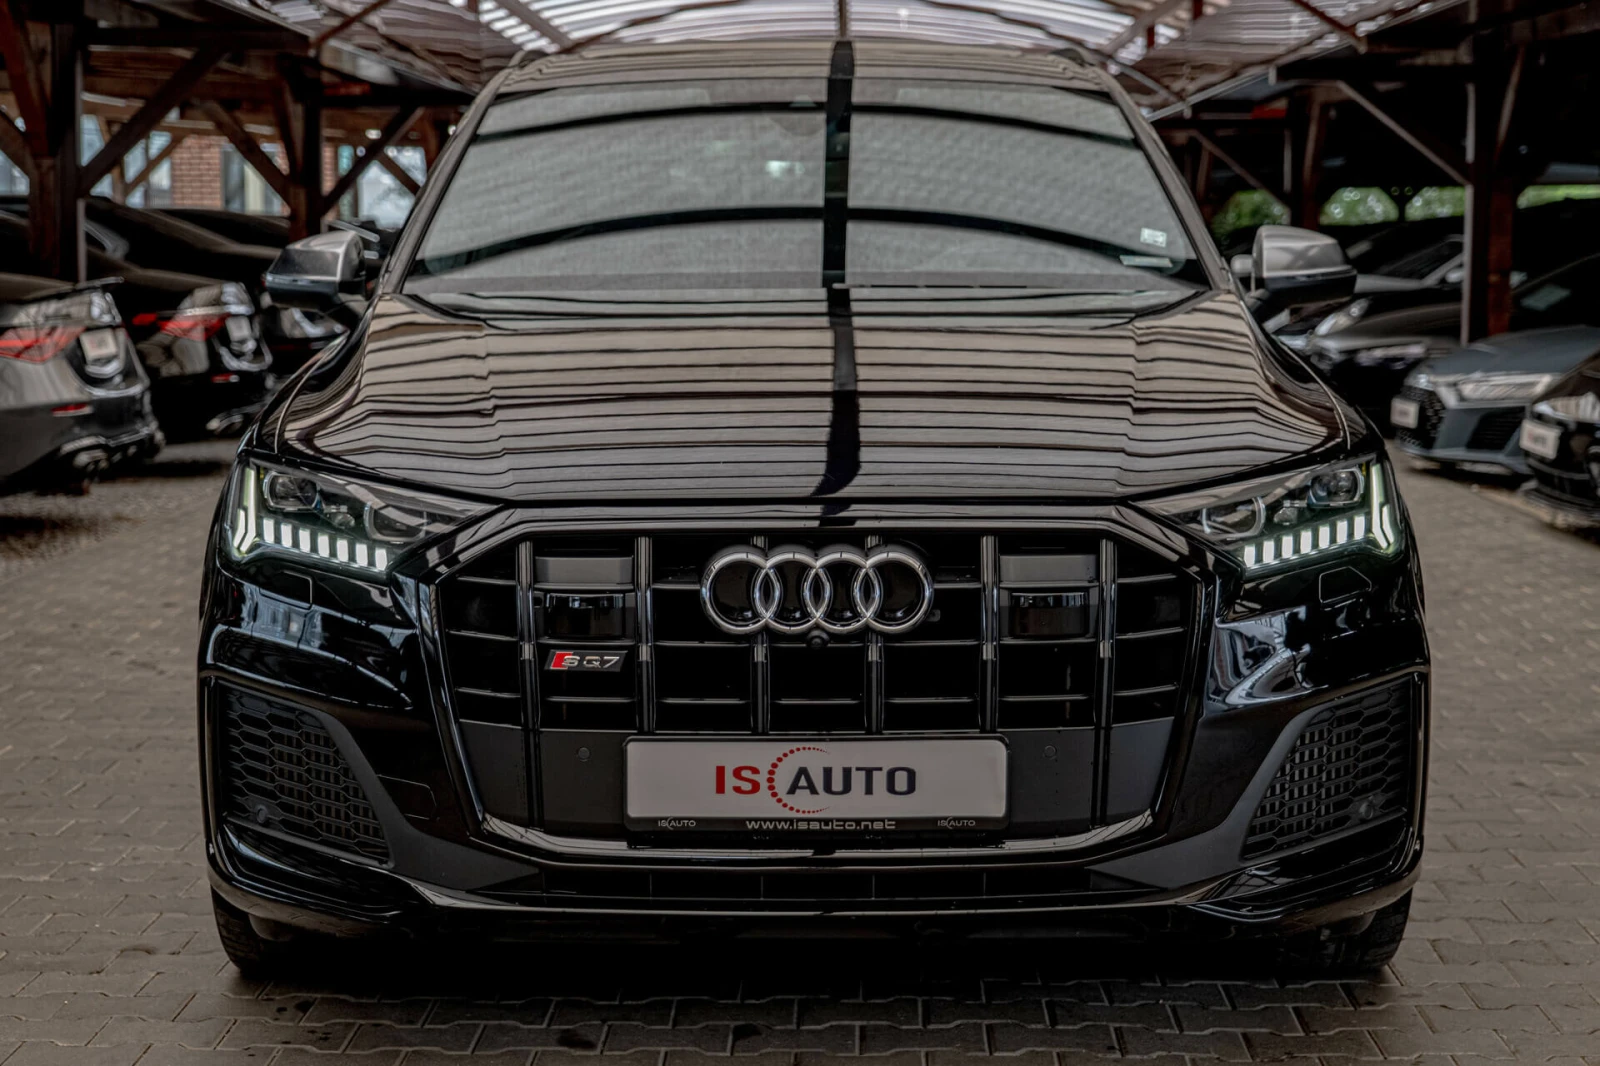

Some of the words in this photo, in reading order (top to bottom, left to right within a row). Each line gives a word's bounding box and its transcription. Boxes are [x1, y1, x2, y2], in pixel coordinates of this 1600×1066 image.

[562, 655, 620, 669] SQ7
[715, 765, 761, 795] IS
[786, 766, 917, 796] AUTO
[745, 818, 896, 830] www.isauto.net
